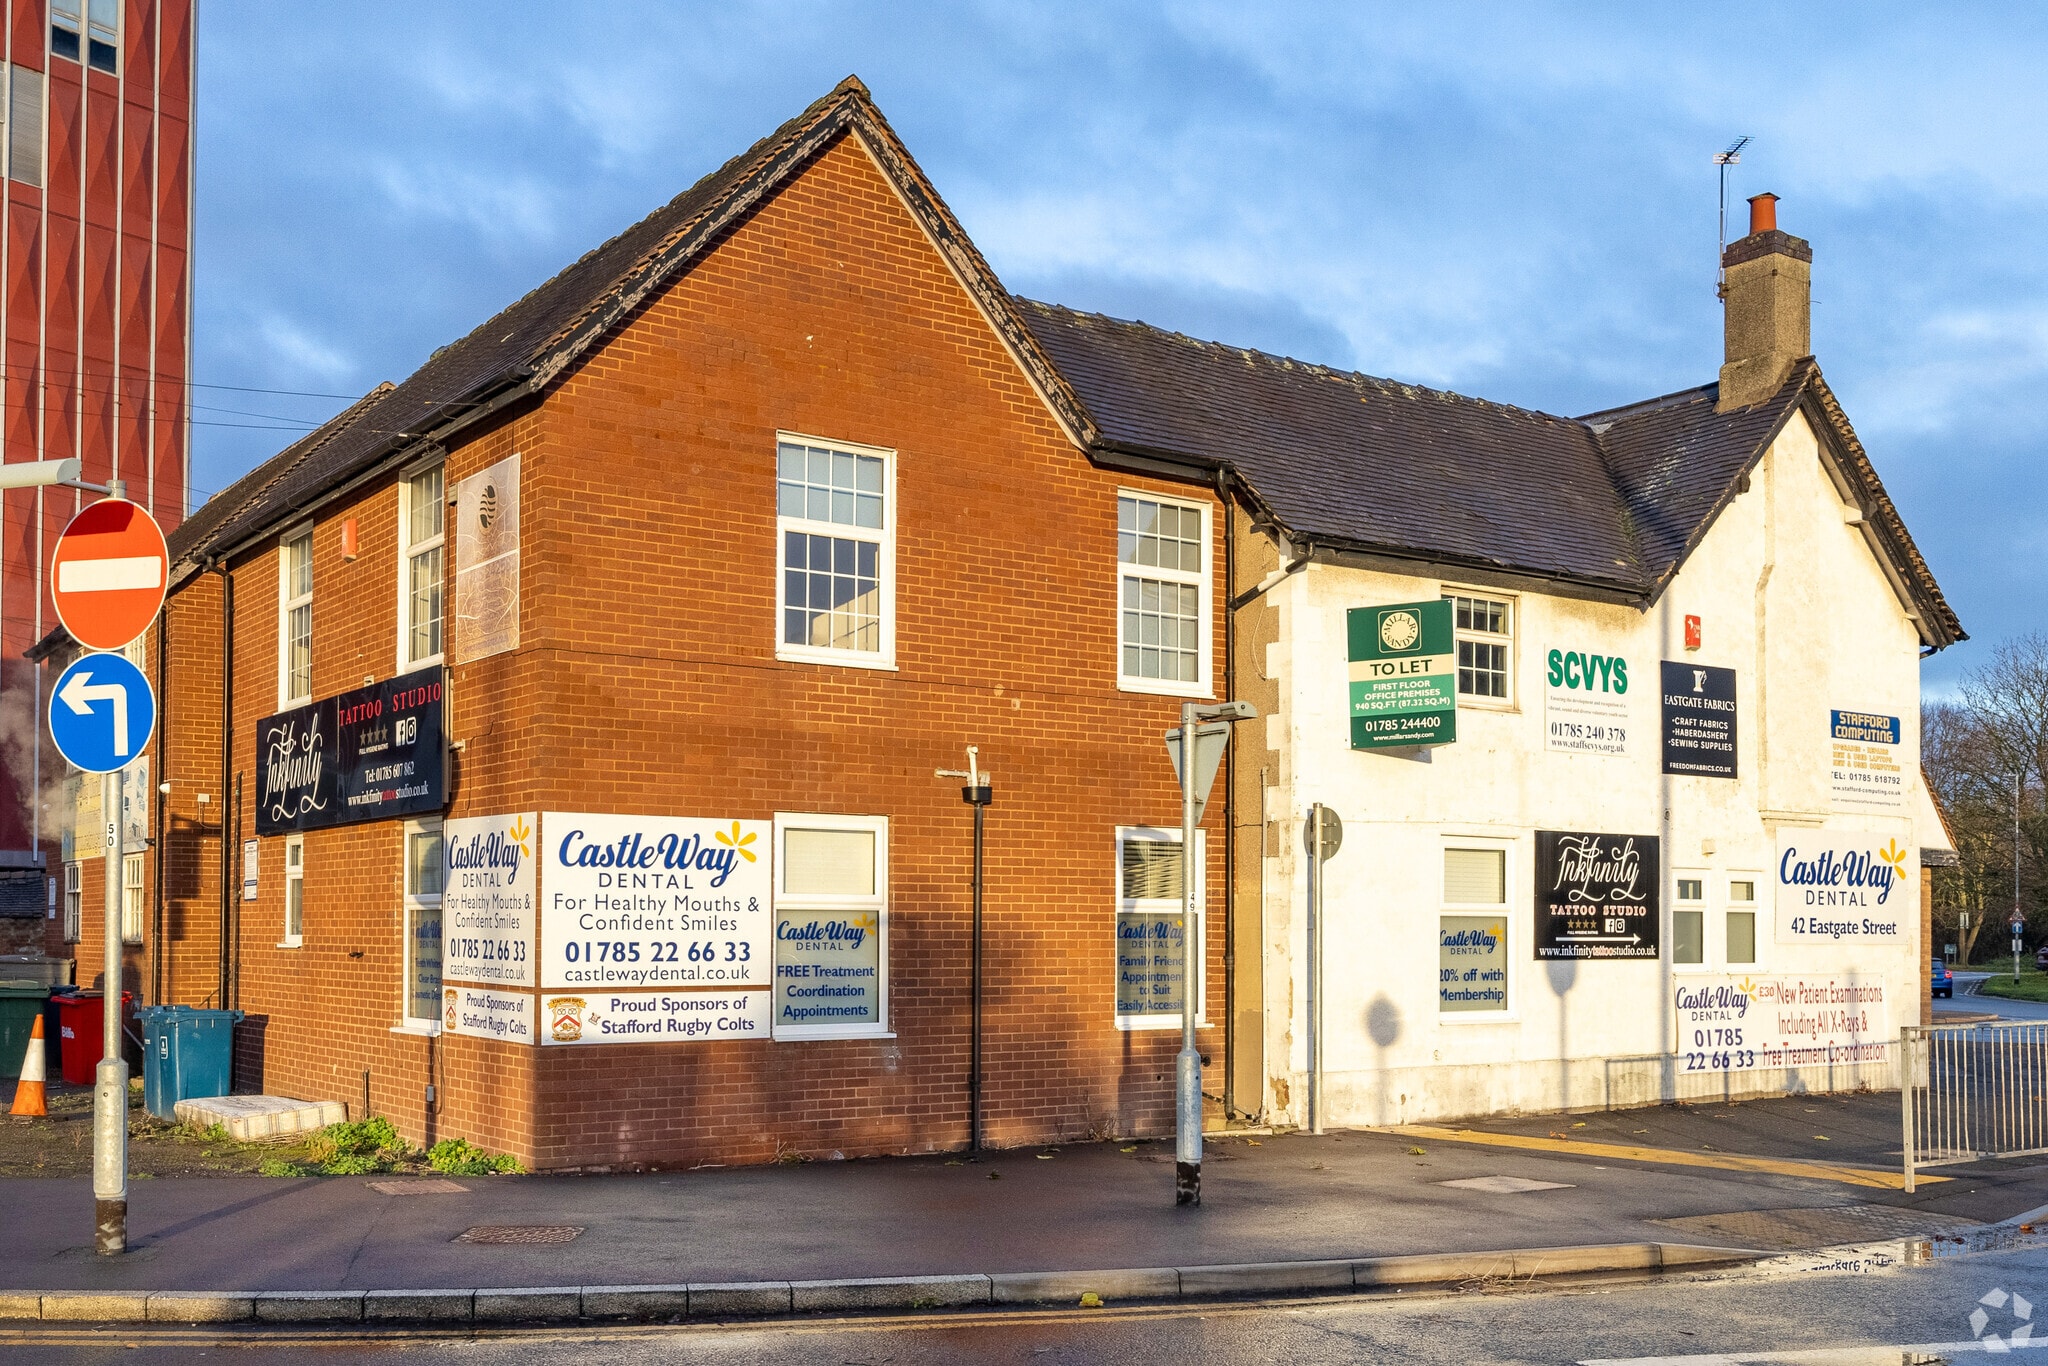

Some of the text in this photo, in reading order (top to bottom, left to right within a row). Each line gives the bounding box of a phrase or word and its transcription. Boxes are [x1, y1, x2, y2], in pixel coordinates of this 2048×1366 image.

[1384, 614, 1416, 632] MILLAR
[1385, 633, 1414, 647] SANDY
[1370, 660, 1432, 676] TO LET
[1548, 649, 1628, 695] SCVYS
[1373, 680, 1431, 691] FIRST FLOOR
[1365, 689, 1440, 701] OFFICE PREMISES
[1665, 694, 1735, 712] EASTGATE FABRICS
[339, 682, 441, 726] TATTOO STUDIO
[1355, 697, 1451, 710] 940 SQ.FT (87.32 SQ.M)
[1366, 717, 1440, 732] 01785 244400
[1699, 719, 1729, 729] FABRICS
[1839, 712, 1890, 729] STAFFORD
[1373, 732, 1434, 741] www.millarsandy.com
[1551, 722, 1626, 742] 01785 240 378
[1835, 725, 1894, 743] COMPUTING
[1552, 739, 1625, 754] www.staffscvys.org.uk
[1701, 741, 1733, 751] SUPPLIES
[365, 770, 376, 783] Tel:
[376, 766, 393, 782] 01785
[403, 761, 415, 776] 862
[1669, 762, 1732, 773] FREEDOMFABRICS.CO.UK
[1849, 772, 1871, 782] 01785
[1875, 775, 1901, 785] 618792
[462, 873, 501, 888] DENTAL
[599, 873, 694, 889] DENTAL
[447, 893, 531, 914] For Healthy Mouths &
[554, 893, 760, 915] For Healthy Mouths &
[1806, 890, 1867, 906] DENTAL
[1550, 904, 1647, 916] TATTOO STUDIO
[455, 912, 520, 929] Confident Smiles
[579, 914, 737, 931] Confident Smiles
[1791, 917, 1897, 939] 42 Eastgate Street
[450, 938, 526, 961] 01785 22 66 33
[565, 942, 751, 962] 01785 22 66 33
[796, 942, 844, 951] DENTAL
[1131, 940, 1169, 949] DENTAL
[1450, 947, 1482, 955] DENTAL
[1539, 945, 1656, 959] www.inkfinitytattoostudio.co.uk
[1120, 955, 1151, 968] Family
[450, 962, 525, 981] castlewaydental.co.uk
[565, 965, 750, 985] castlewaydental.co.uk
[777, 965, 875, 977] FREE Treatment
[1121, 971, 1183, 985] Appointmen
[1463, 968, 1478, 981] off
[1481, 968, 1504, 981] with
[787, 984, 865, 998] Coordination
[1139, 984, 1172, 995] to Suit
[1759, 980, 1883, 1005] £30 New Patient Examinations
[467, 993, 524, 1013] Proud Sponsors of
[611, 996, 748, 1014] Proud Sponsors of
[1117, 1000, 1144, 1013] Easily
[783, 1004, 869, 1021] Appointments
[1692, 1010, 1732, 1021] DENTAL
[463, 1013, 527, 1036] Stafford Rugby Colts
[601, 1017, 754, 1036] Stafford Rugby Colts
[1778, 1010, 1868, 1040] Including All X-Rays &
[1695, 1028, 1743, 1047] 01785
[1686, 1050, 1754, 1070] 22 66 33
[1763, 1039, 1885, 1066] Free Treatment Co-ordination
